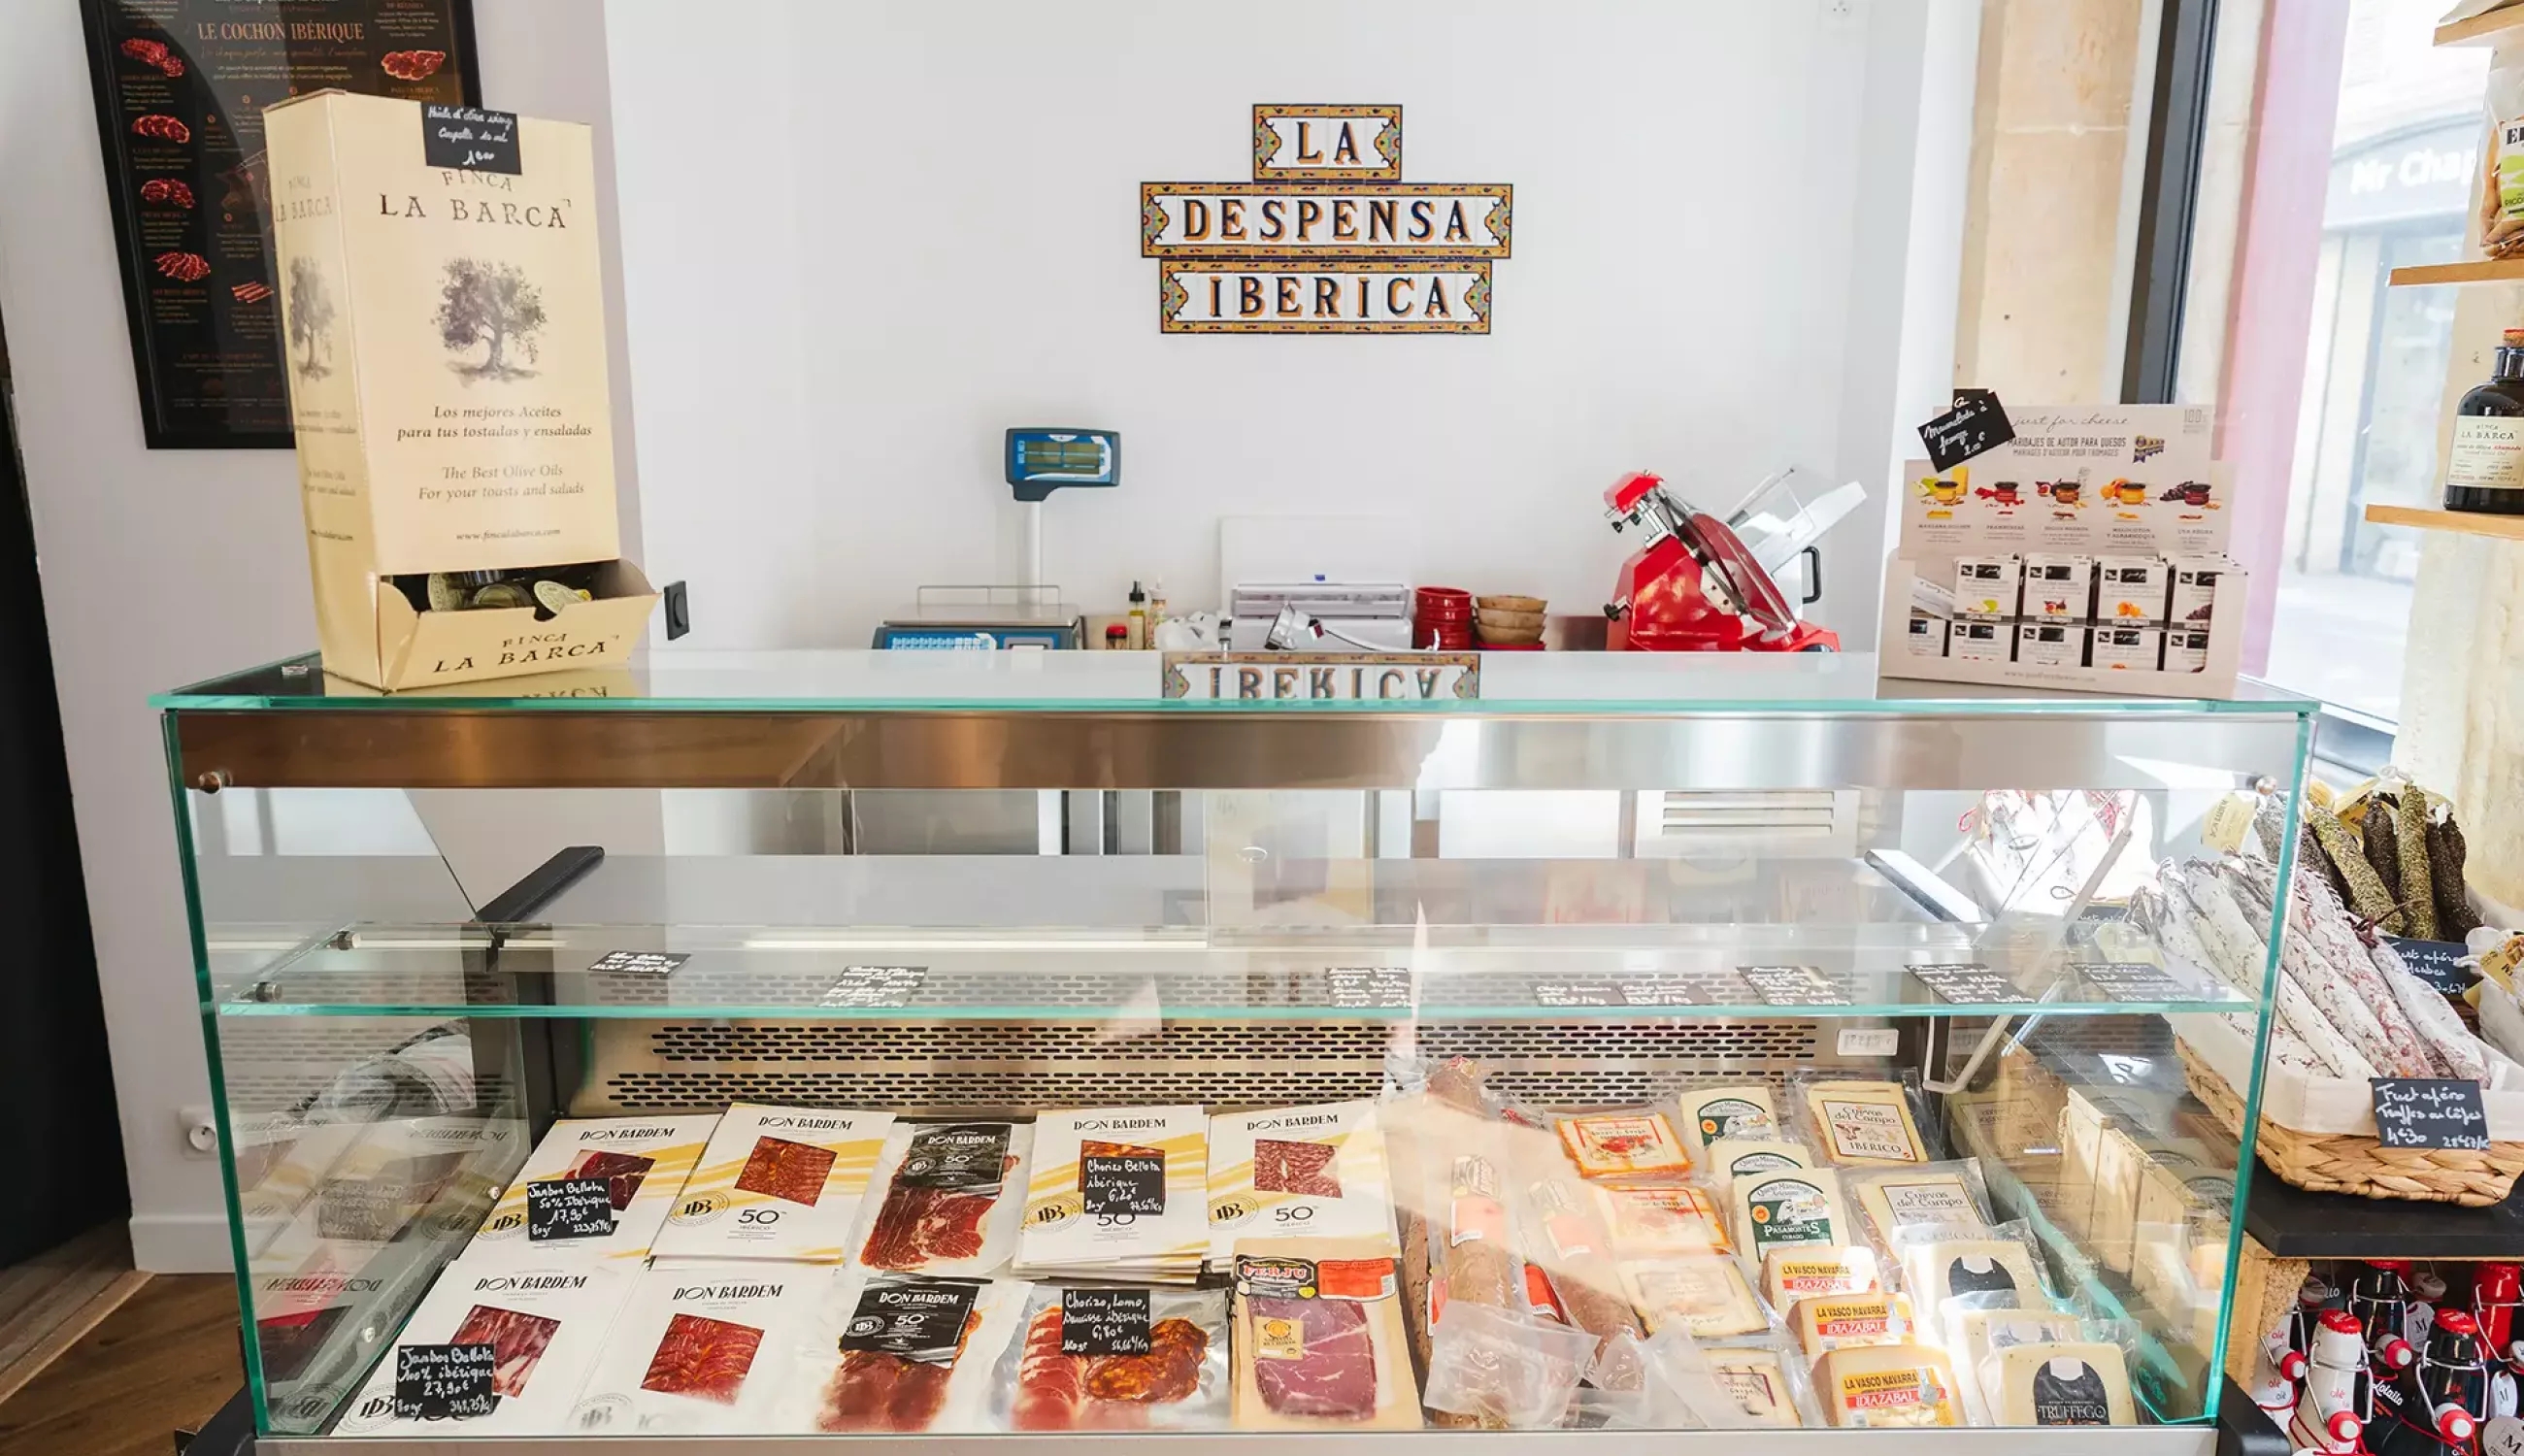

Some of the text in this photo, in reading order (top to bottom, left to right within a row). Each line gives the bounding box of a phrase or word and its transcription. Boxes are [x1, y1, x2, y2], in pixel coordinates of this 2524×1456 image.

[197, 22, 217, 40] LE
[220, 21, 285, 41] COCHON
[291, 19, 365, 44] IBÉRIQUE
[1296, 120, 1362, 165] LA
[442, 169, 513, 192] FINCA
[2350, 158, 2393, 194] Mr
[290, 196, 333, 220] BARCA
[379, 193, 567, 229] LA BARCA
[1182, 198, 1472, 243] DESPENSA
[1210, 276, 1452, 318] IBERICA
[434, 406, 561, 421] Los mejores Aceites
[2046, 414, 2077, 433] for
[2080, 414, 2130, 426] cheese
[397, 424, 592, 442] para tus tostadas y ensaladas
[2057, 438, 2079, 447] AUTOR
[2080, 438, 2100, 447] PARA
[2101, 438, 2126, 447] QUESOS
[442, 464, 563, 480] The Best Olive Oils
[418, 482, 584, 503] For your toasts and salads
[502, 633, 568, 647] FINCA
[433, 641, 607, 673] LA BARCA
[758, 1116, 853, 1131] DON BARDEM
[1073, 1117, 1166, 1130] DON BARDEM
[1247, 1114, 1339, 1131] DON BARDEM
[579, 1127, 676, 1141] DON BARDEM
[928, 1135, 996, 1144] DON BARDEM
[1125, 1159, 1161, 1173] Bellota
[527, 1181, 605, 1198] Jambon Bellota
[1905, 1191, 1948, 1200] Cuevas
[540, 1197, 564, 1208] 50%
[1764, 1221, 1820, 1237] PASAMONTES
[1783, 1266, 1792, 1274] LA
[1793, 1265, 1817, 1274] VASCO
[474, 1275, 588, 1291] DON BARDEM
[672, 1284, 783, 1301] DON BARDEM
[879, 1291, 959, 1305] DON BARDEM
[1816, 1305, 1887, 1318] LA VASCO NAVARRA
[400, 1347, 448, 1370] Jambon
[423, 1379, 470, 1399] 27,90€
[1844, 1373, 1918, 1389] LA VASCO NAVARRA
